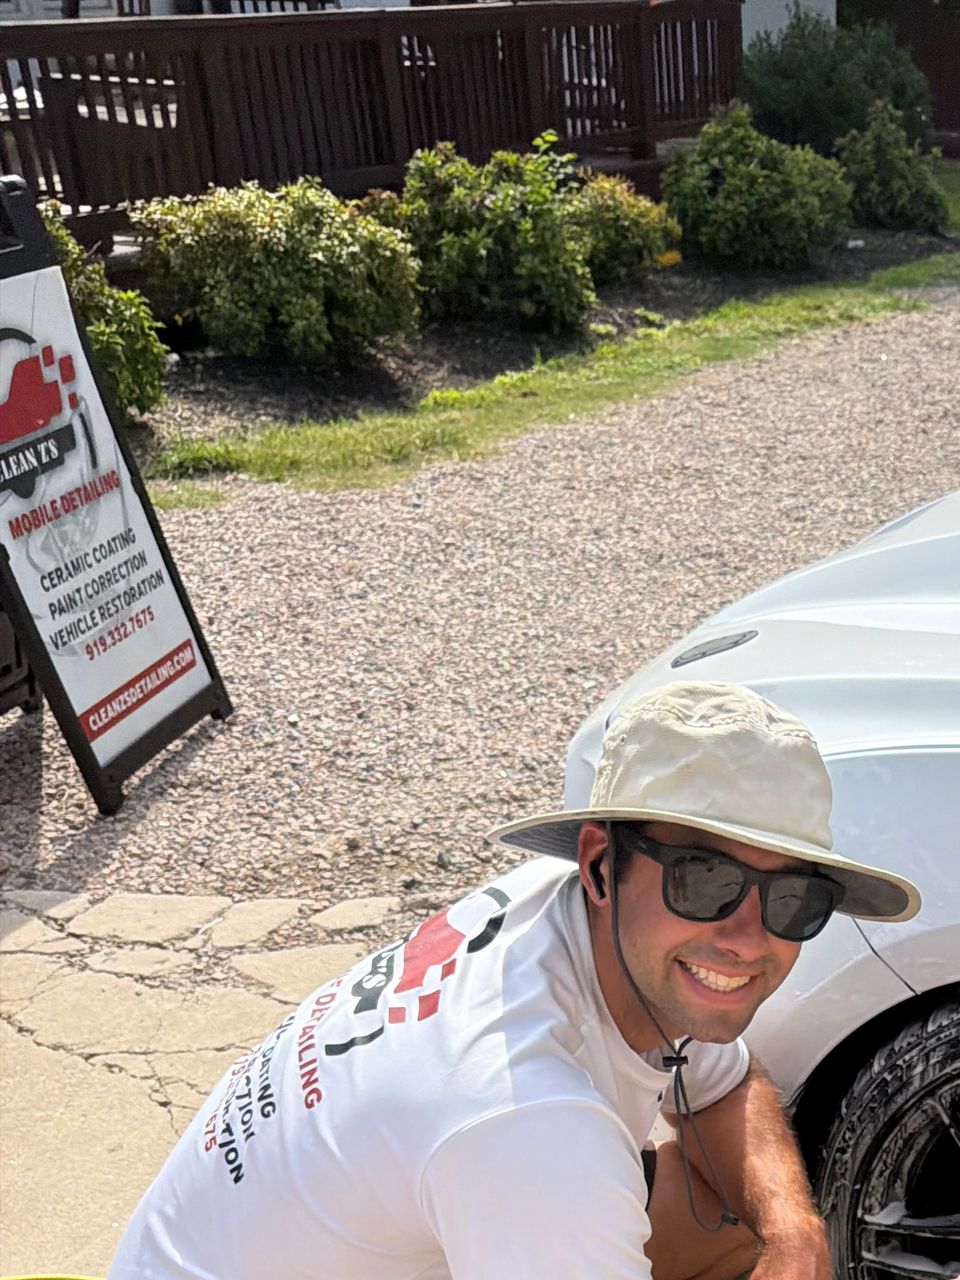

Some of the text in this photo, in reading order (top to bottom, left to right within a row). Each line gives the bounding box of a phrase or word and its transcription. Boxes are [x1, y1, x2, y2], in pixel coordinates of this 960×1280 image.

[8, 469, 120, 540] MOBILE DETAILING
[40, 527, 137, 593] CERAMIC COATING
[48, 549, 148, 622] PAINT CORRECTION
[49, 568, 165, 651] VEHICLE RESTORATION
[85, 604, 155, 661] 919.332.7675
[88, 645, 194, 732] CLEANZSDETAILING.COM
[298, 992, 337, 1110] DETAILING
